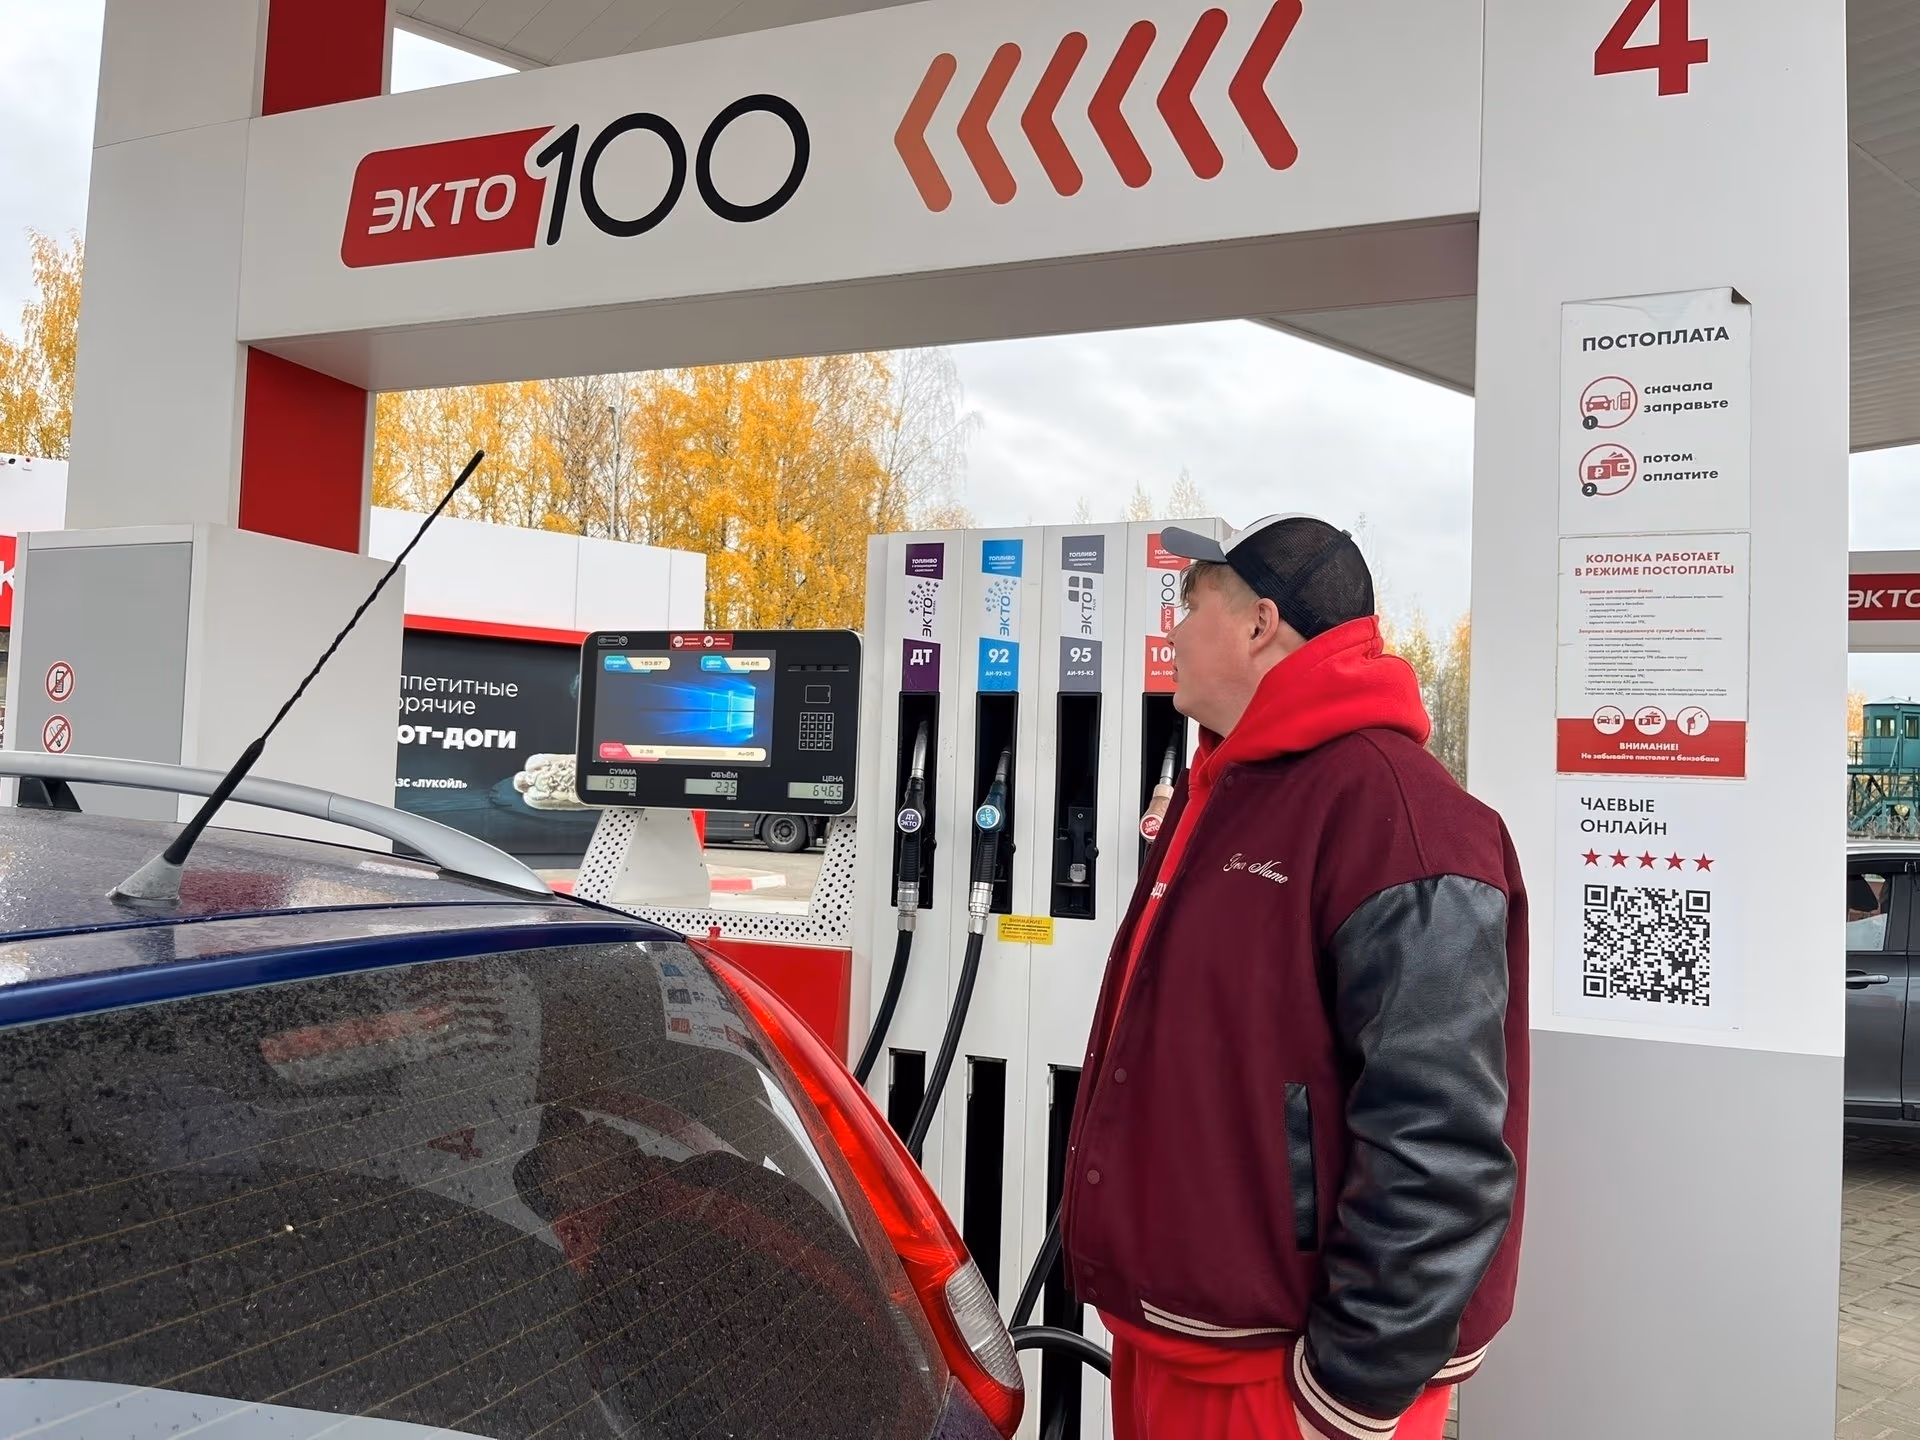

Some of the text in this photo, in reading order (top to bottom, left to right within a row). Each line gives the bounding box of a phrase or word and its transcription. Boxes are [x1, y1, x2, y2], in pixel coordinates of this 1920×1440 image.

[1593, 0, 1709, 96] 4
[368, 93, 811, 246] ЭКТО 100
[1582, 326, 1730, 351] ПОСТОПЛАТА
[1644, 381, 1713, 395] сначала
[1643, 399, 1729, 414] заправьте
[1643, 452, 1693, 464] потом
[1643, 469, 1719, 482] оплатите
[1586, 551, 1720, 563] КОЛОНКА РАБОТАЕТ
[1574, 565, 1735, 577] В РЕЖИМЕ ПОСТОПЛАТЫ
[1161, 573, 1175, 608] 100
[922, 597, 933, 637] ЭКТО
[1000, 595, 1011, 636] ЭКТО
[1081, 592, 1093, 635] ЭКТО
[910, 649, 933, 665] ДТ
[988, 648, 1010, 664] 92
[1069, 647, 1092, 663] 95
[1150, 647, 1176, 663] 10
[1619, 742, 1679, 751] ВНИМАНИЕ!
[1580, 752, 1592, 760] Не
[1677, 754, 1720, 763] бензобаке
[711, 771, 738, 779] ОБЪЁМ
[822, 775, 844, 783] ЦЕНА
[411, 778, 468, 789] «ЛУКОЙЛ»
[1581, 797, 1655, 813] ЧАЕВЫЕ
[900, 819, 917, 827] ЭКТО
[1580, 818, 1667, 836] ОНЛАЙН
[1248, 859, 1289, 884] Name
